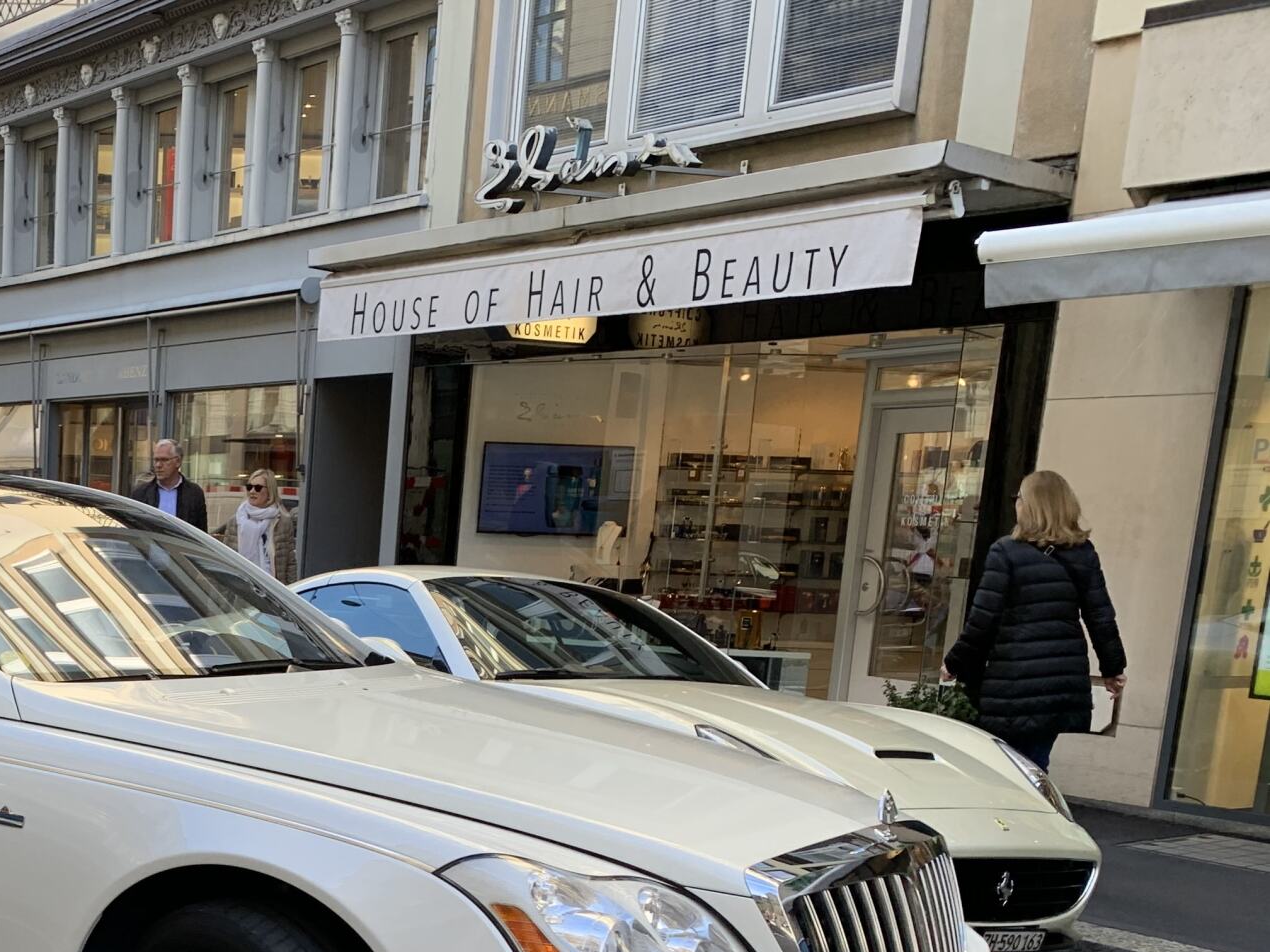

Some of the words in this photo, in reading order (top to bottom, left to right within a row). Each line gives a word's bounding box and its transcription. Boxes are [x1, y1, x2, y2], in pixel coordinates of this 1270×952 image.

[351, 291, 440, 335] HOUSE
[464, 287, 499, 324] OF
[527, 269, 603, 319] HAIR
[636, 254, 656, 308] &
[692, 244, 849, 301] BEAUTY
[514, 323, 585, 340] KOSMETIK
